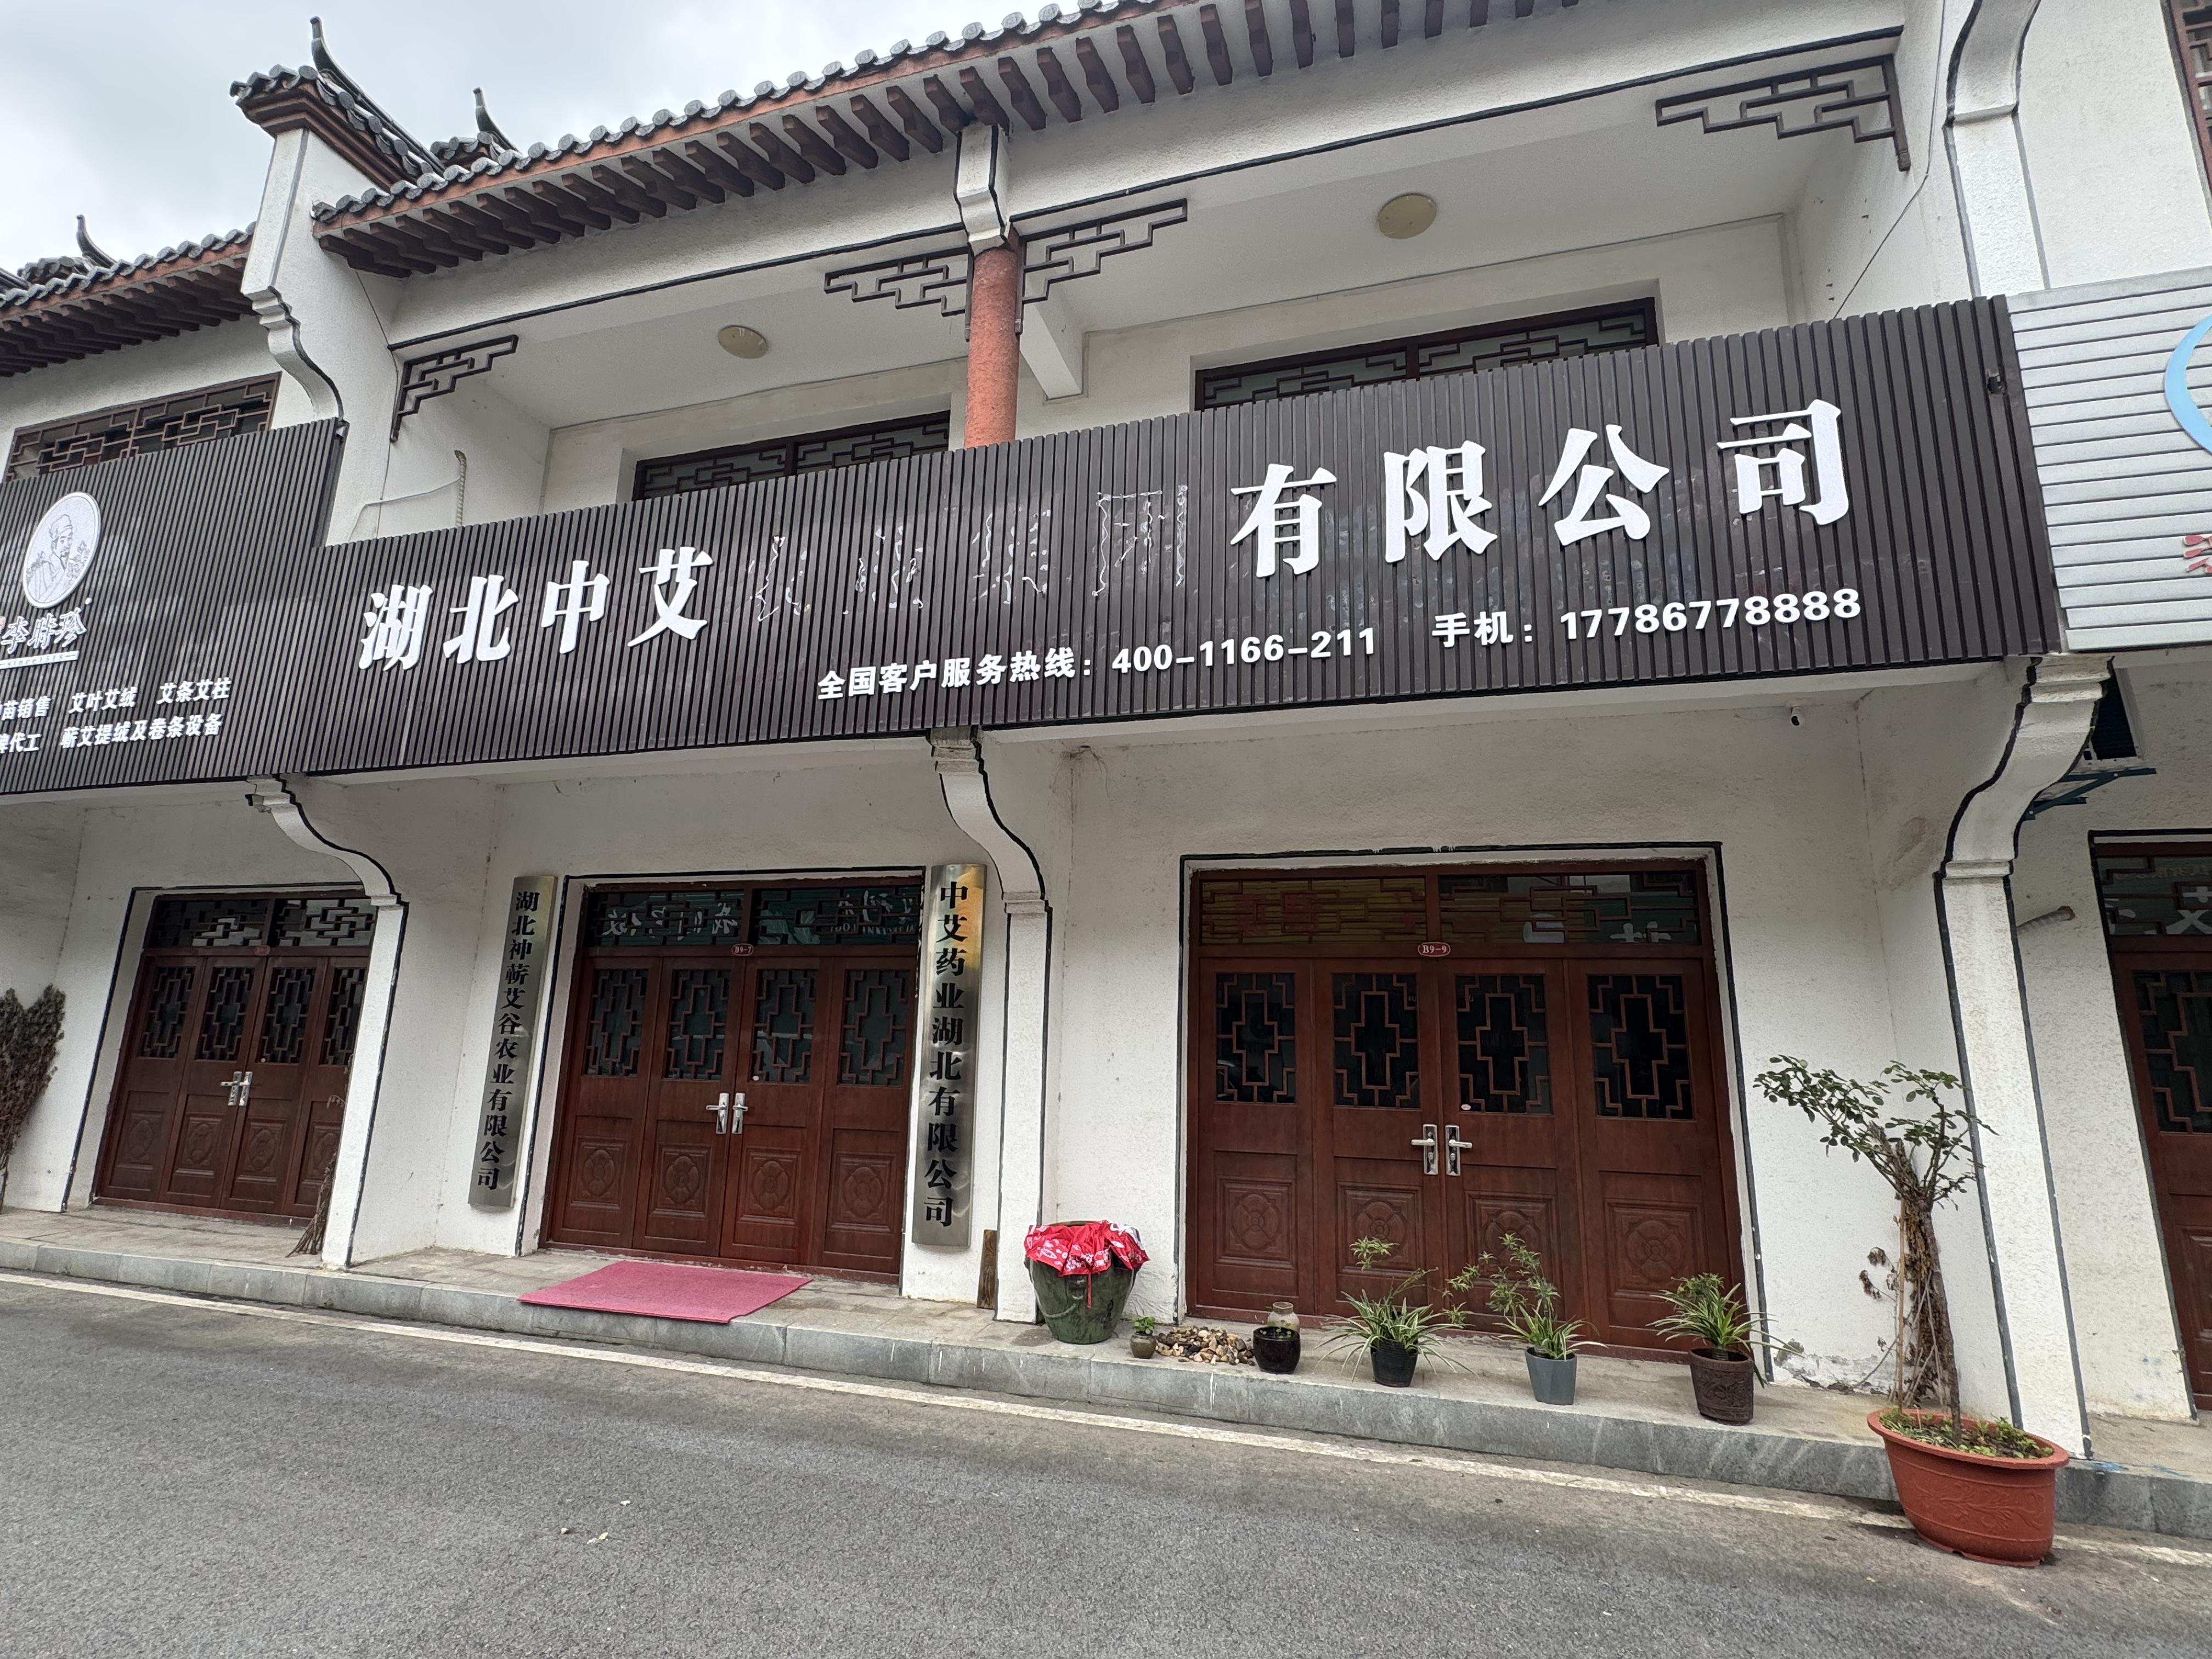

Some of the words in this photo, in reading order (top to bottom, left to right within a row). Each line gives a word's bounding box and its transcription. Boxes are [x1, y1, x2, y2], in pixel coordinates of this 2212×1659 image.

[359, 546, 713, 671] 湖北中艾
[1230, 399, 1849, 577] 有限公司
[0, 696, 51, 721] 苗销售
[69, 686, 137, 713] 艾叶艾绒
[817, 647, 1091, 699] 全国客户服务热线：
[1112, 627, 1374, 673] 400-1166-211
[1432, 611, 1532, 647] 手机：
[1561, 588, 1860, 639] 17786778888
[478, 891, 540, 1190] 湖北神蕲艾谷农业有限公司
[1423, 945, 1447, 953] B9-9
[923, 881, 968, 1227] 中艾药业湖北有限公司
